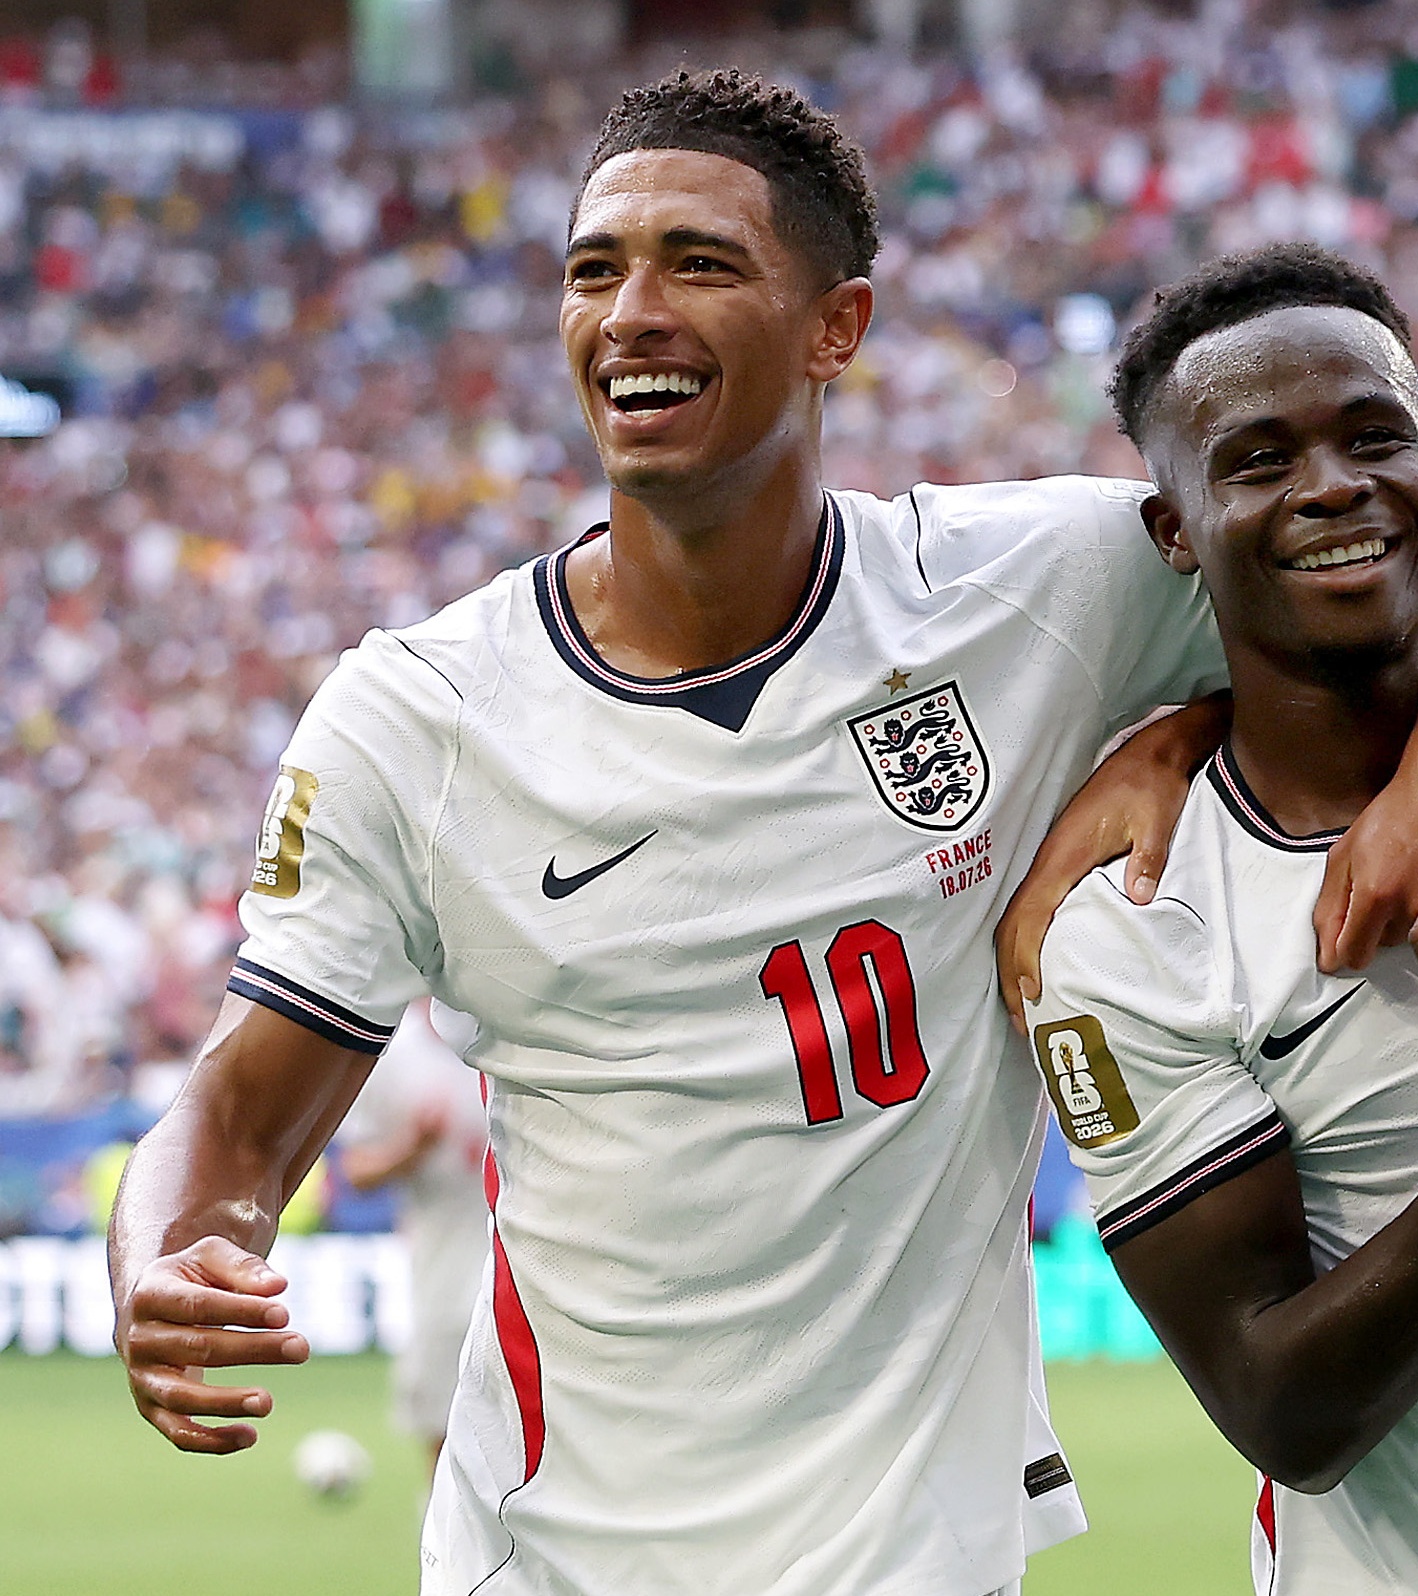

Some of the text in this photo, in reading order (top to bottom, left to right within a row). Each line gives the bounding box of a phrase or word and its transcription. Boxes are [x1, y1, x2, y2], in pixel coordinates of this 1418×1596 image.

[925, 828, 992, 874] FRANCE
[939, 856, 993, 899] 18.07.26
[758, 918, 931, 1127] 10
[1073, 1096, 1092, 1107] FIFA
[1093, 1111, 1110, 1123] CUP
[1074, 1120, 1115, 1141] 2026
